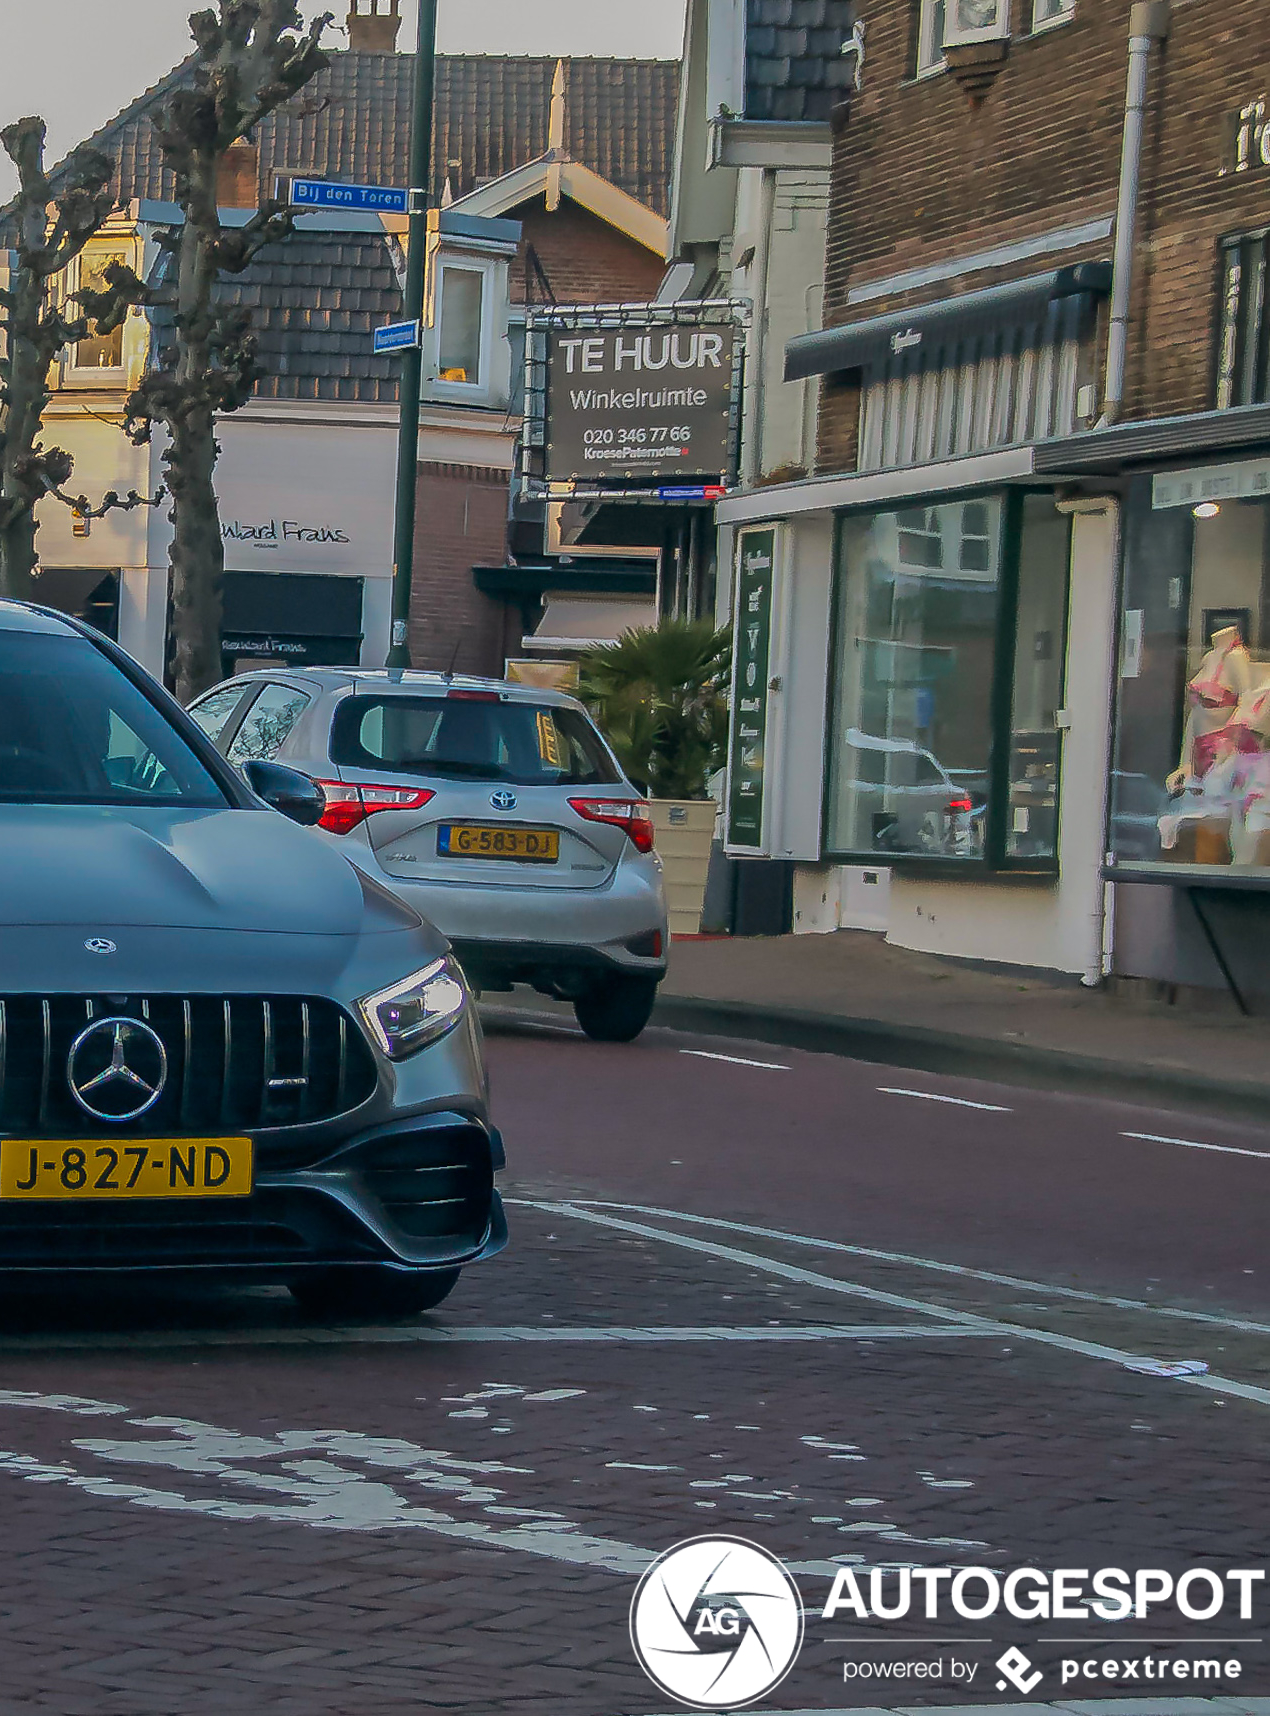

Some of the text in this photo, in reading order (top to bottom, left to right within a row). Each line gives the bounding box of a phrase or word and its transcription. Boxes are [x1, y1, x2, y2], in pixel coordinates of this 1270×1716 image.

[298, 184, 402, 204] Bij den Toren
[558, 333, 723, 374] TE HUUR
[569, 386, 708, 410] Winkelruimte
[583, 426, 692, 444] 020 346 77 66
[282, 520, 351, 544] Frans
[457, 829, 550, 854] G-583-DJ
[15, 1145, 231, 1191] J-827-ND
